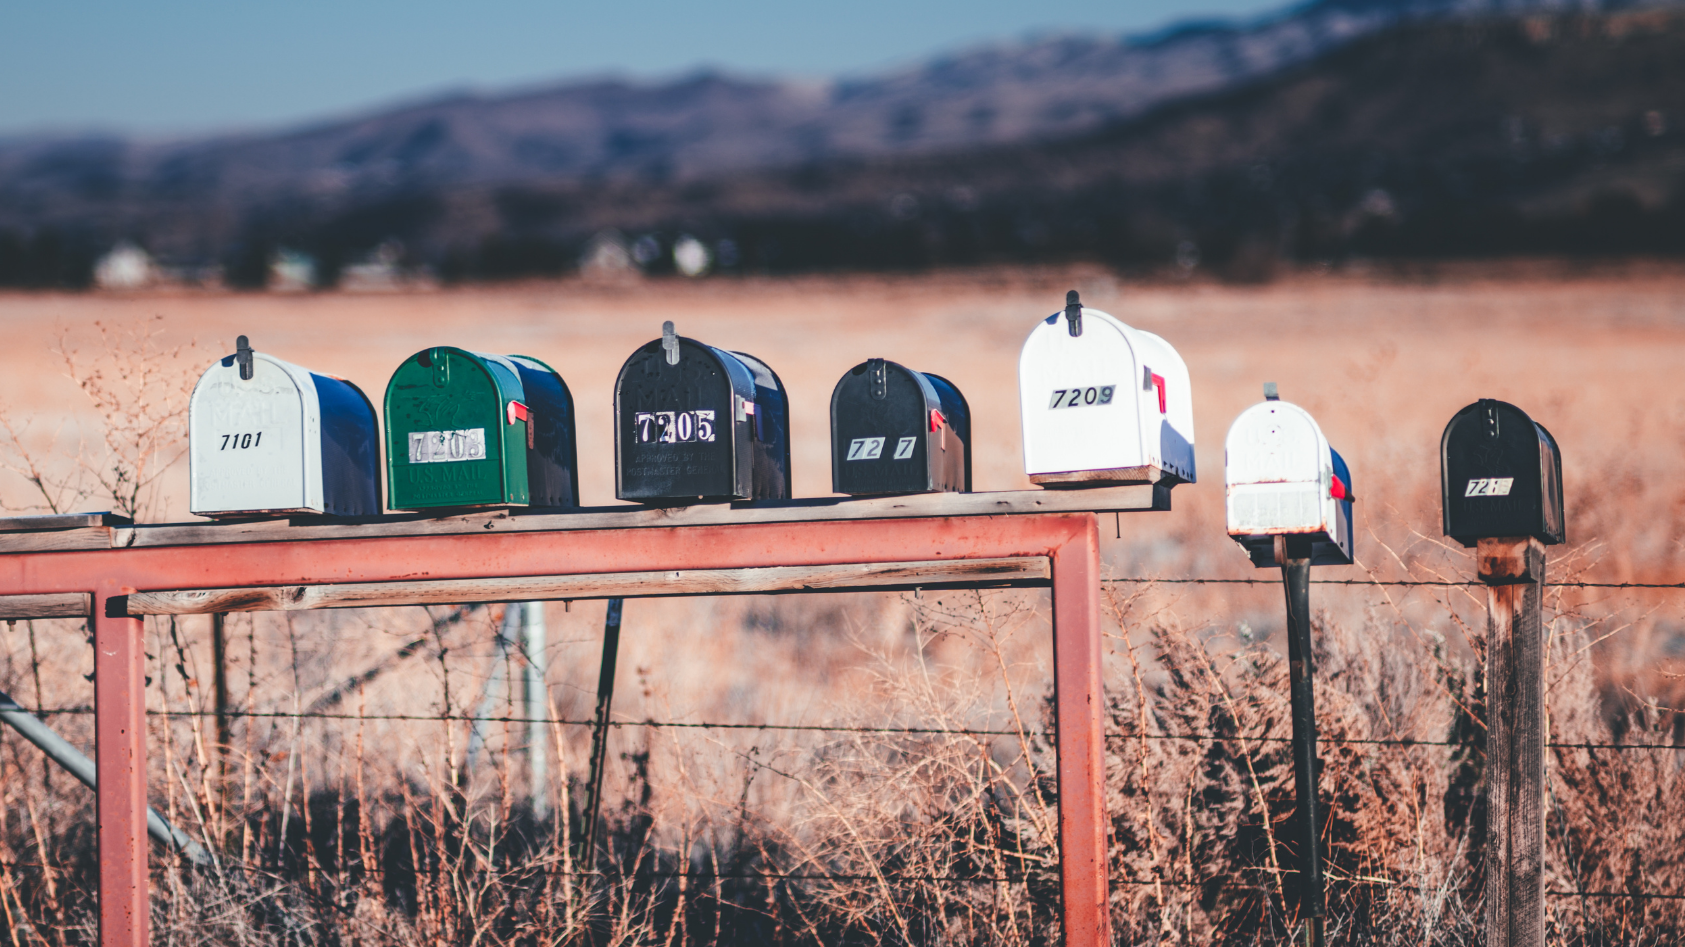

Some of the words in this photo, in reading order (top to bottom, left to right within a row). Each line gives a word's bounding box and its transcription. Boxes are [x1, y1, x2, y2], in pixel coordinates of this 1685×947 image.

[1053, 386, 1113, 408] 7209
[637, 411, 714, 442] 7205
[220, 431, 262, 451] 7101
[411, 429, 484, 461] 7203
[635, 453, 679, 463] APPROVED
[683, 452, 694, 462] BY
[406, 467, 438, 485] U.S.
[440, 464, 487, 482] MAIL
[626, 466, 681, 477] POSTMASTER
